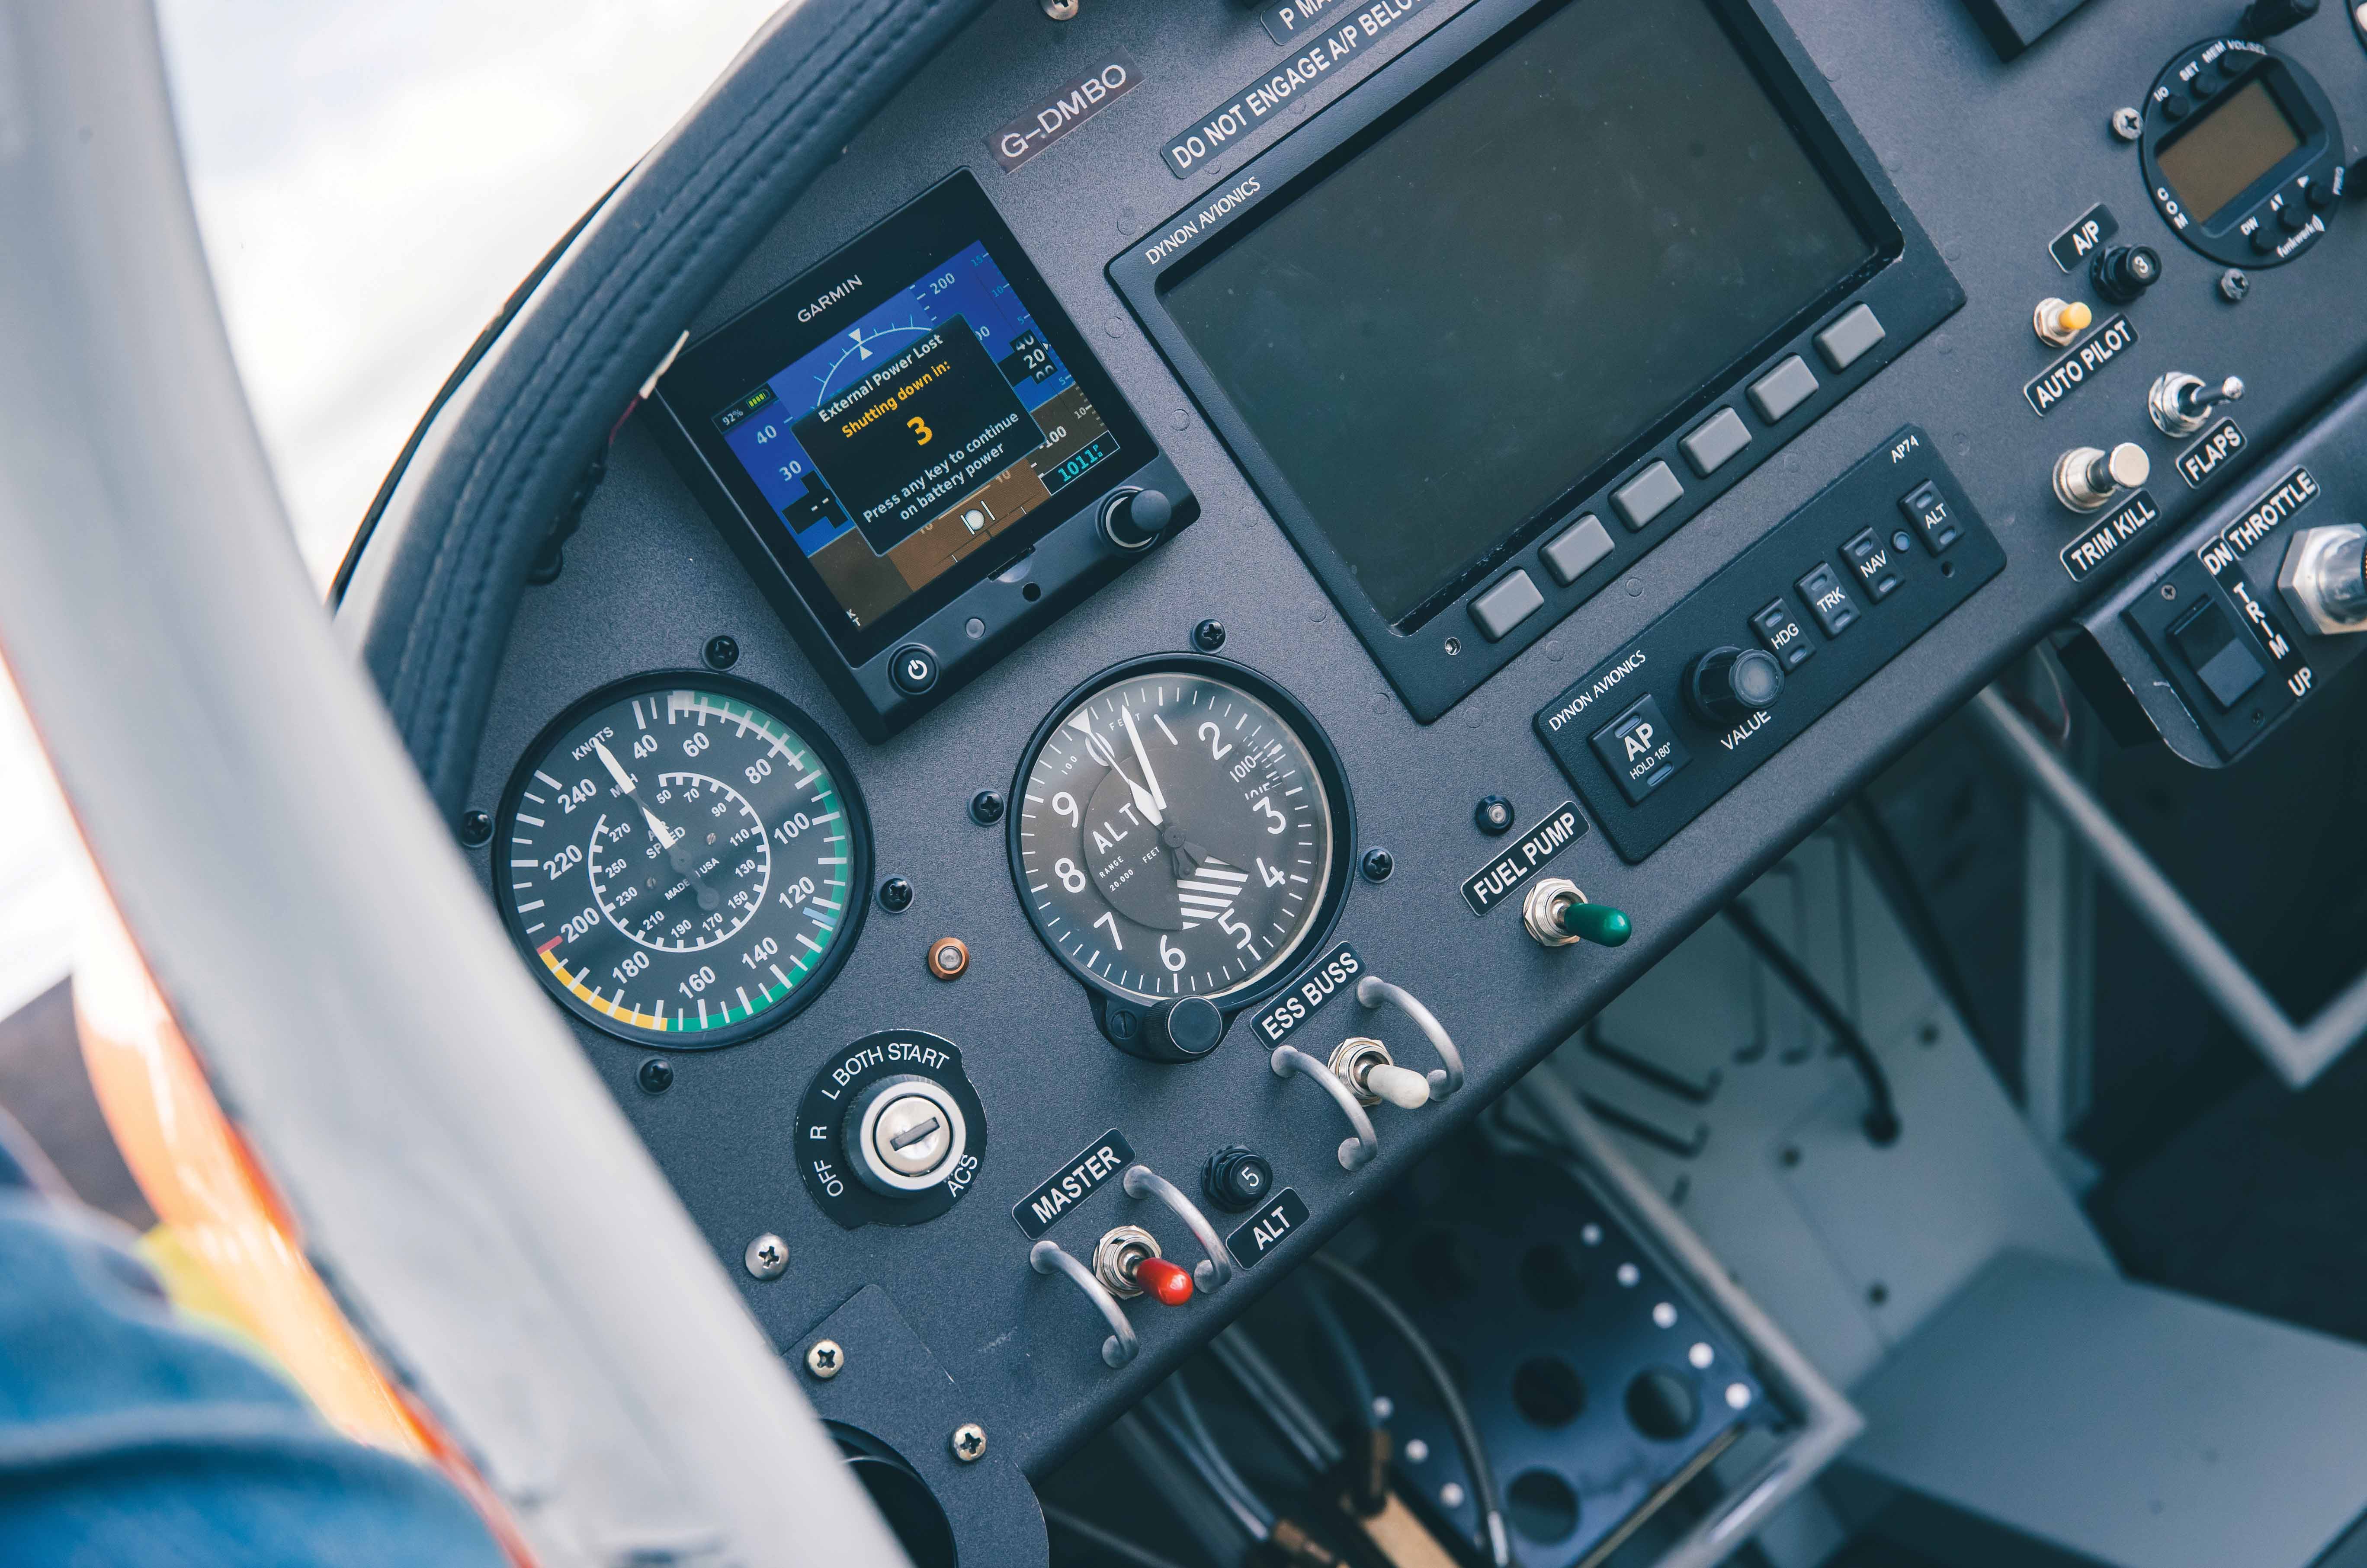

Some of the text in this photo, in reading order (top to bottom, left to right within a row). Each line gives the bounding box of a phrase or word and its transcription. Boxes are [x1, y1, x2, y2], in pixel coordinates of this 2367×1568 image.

[1279, 7, 1294, 30] P
[2202, 41, 2227, 64] MEM
[1172, 0, 1421, 169] DO NOT ENGAGE A/P BELO
[2179, 61, 2200, 81] SET
[1000, 64, 1126, 158] G-DMBO
[1145, 176, 1260, 266] DYNON AVIONICS
[2156, 188, 2188, 230] COM
[2072, 220, 2099, 256] A/P
[2134, 256, 2148, 274] 3
[797, 274, 863, 323] GARMIN
[930, 273, 955, 294] 200
[992, 286, 1004, 298] 10
[1017, 317, 1024, 325] 5
[1023, 349, 1045, 369] 20
[2036, 321, 2131, 408] AUTO PILOT
[818, 334, 943, 422] External Power Lost
[1058, 377, 1066, 385] 5
[841, 361, 951, 438] Shutting down in:
[1074, 408, 1087, 419] 10
[722, 409, 743, 426] 92%
[907, 416, 933, 446] 3
[756, 425, 777, 445] 40
[1891, 435, 1919, 464] AP74
[863, 413, 1019, 523] Press any key to continue
[1058, 450, 1098, 482] 1011
[2185, 426, 2241, 481] FLAPS
[779, 461, 802, 481] 30
[900, 443, 1004, 520] on battery power
[1924, 502, 1947, 530] ALT
[2229, 471, 2316, 552] THROTTLE
[2070, 501, 2155, 572] TRIM KILL
[1860, 550, 1887, 578] NAV
[2203, 542, 2233, 576] DN
[1816, 586, 1846, 612] TRK
[1771, 623, 1799, 650] HDG
[1549, 650, 1646, 731] DYNON AVIONICS
[2287, 667, 2312, 697] UP
[1109, 713, 1140, 731] FET
[1153, 714, 1178, 745] 1
[1720, 710, 1772, 751] VALUE
[572, 726, 614, 761] KNOTS
[633, 735, 658, 760] 40
[683, 733, 709, 758] 60
[1199, 721, 1232, 760] 2
[1624, 723, 1654, 762] AP
[745, 759, 771, 784] 80
[1230, 755, 1256, 783] 1010
[1629, 757, 1655, 780] HOLD
[557, 779, 597, 814] 240
[610, 773, 638, 798] MH
[656, 790, 671, 803] 50
[683, 788, 699, 803] 70
[711, 802, 727, 817] 90
[1052, 791, 1079, 828] 9
[1253, 797, 1286, 834] 3
[609, 823, 631, 842] 270
[730, 829, 750, 846] 110
[774, 813, 810, 845] 100
[1093, 802, 1139, 854] ALT
[543, 845, 583, 881] 220
[605, 858, 627, 878] 250
[735, 859, 755, 877] 130
[1099, 856, 1124, 878] RANGE
[1142, 846, 1160, 863] FEET
[1473, 813, 1575, 905] FUEL PUMP
[664, 858, 719, 900] MADE USA
[1054, 858, 1085, 893] 8
[1256, 858, 1285, 888] 4
[616, 886, 638, 906] 230
[728, 891, 748, 909] 150
[779, 877, 815, 909] 120
[560, 908, 600, 943] 200
[643, 911, 664, 930] 210
[671, 920, 692, 938] 190
[702, 913, 723, 931] 170
[1094, 911, 1122, 950] 7
[1218, 908, 1251, 949] 5
[612, 951, 650, 984] 180
[742, 937, 778, 970] 140
[1160, 934, 1186, 972] 6
[679, 966, 715, 998] 160
[1261, 952, 1359, 1040] ESS BUSS
[832, 1046, 884, 1086] BOTH
[888, 1043, 950, 1069] START
[821, 1089, 840, 1100] L
[810, 1126, 827, 1139] R
[814, 1160, 844, 1197] OFF
[1031, 1146, 1121, 1224] MASTER
[1241, 1167, 1260, 1187] 5
[1253, 1206, 1291, 1251] ALT
